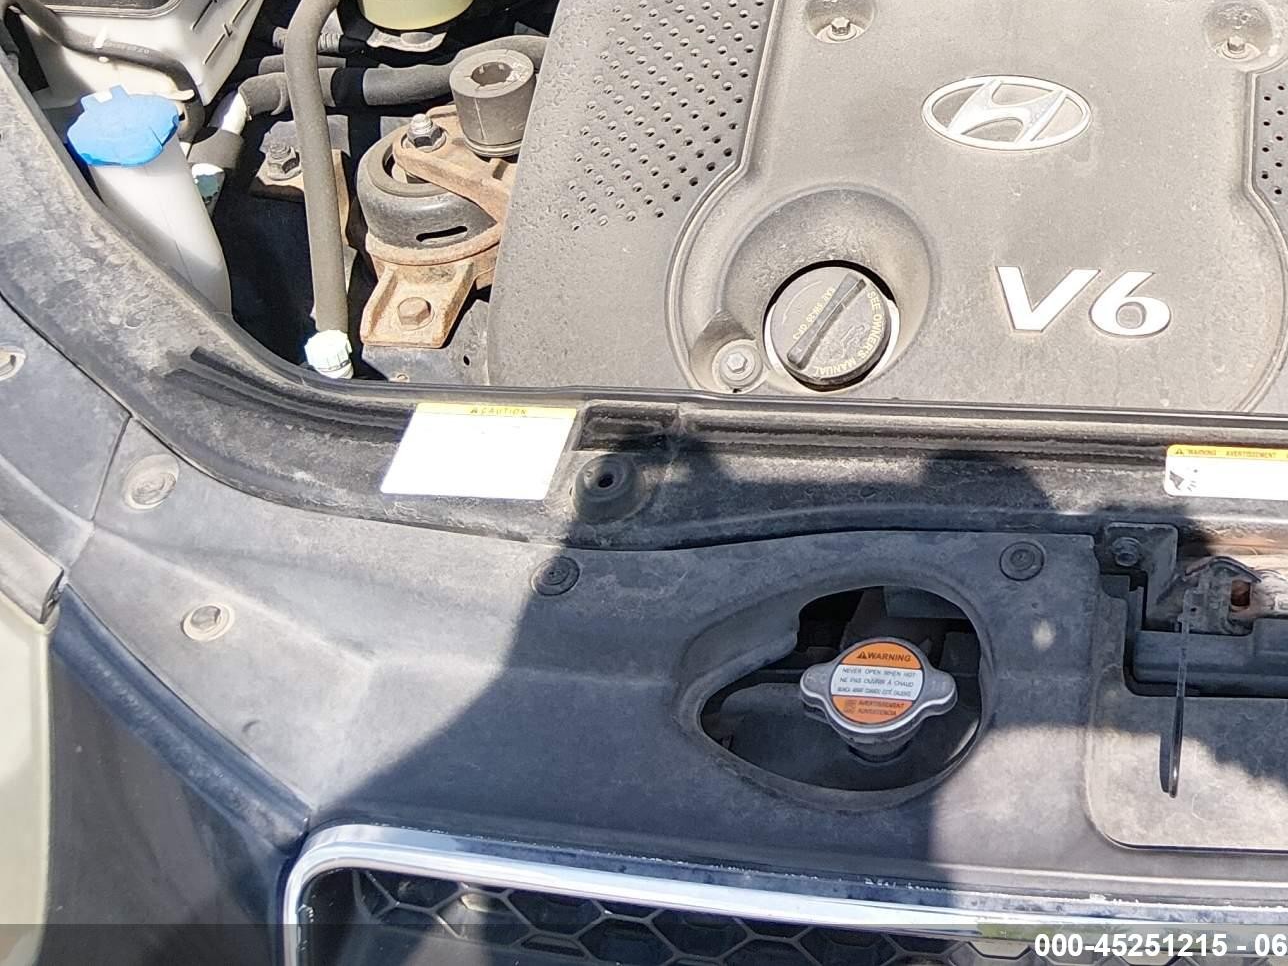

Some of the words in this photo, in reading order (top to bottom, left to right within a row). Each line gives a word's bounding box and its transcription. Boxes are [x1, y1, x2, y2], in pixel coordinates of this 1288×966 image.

[224, 24, 233, 37] L
[867, 290, 881, 311] SEE
[995, 265, 1172, 338] V6
[814, 356, 857, 375] MANUAL
[481, 407, 526, 415] CAUTION
[867, 651, 912, 662] WARNING
